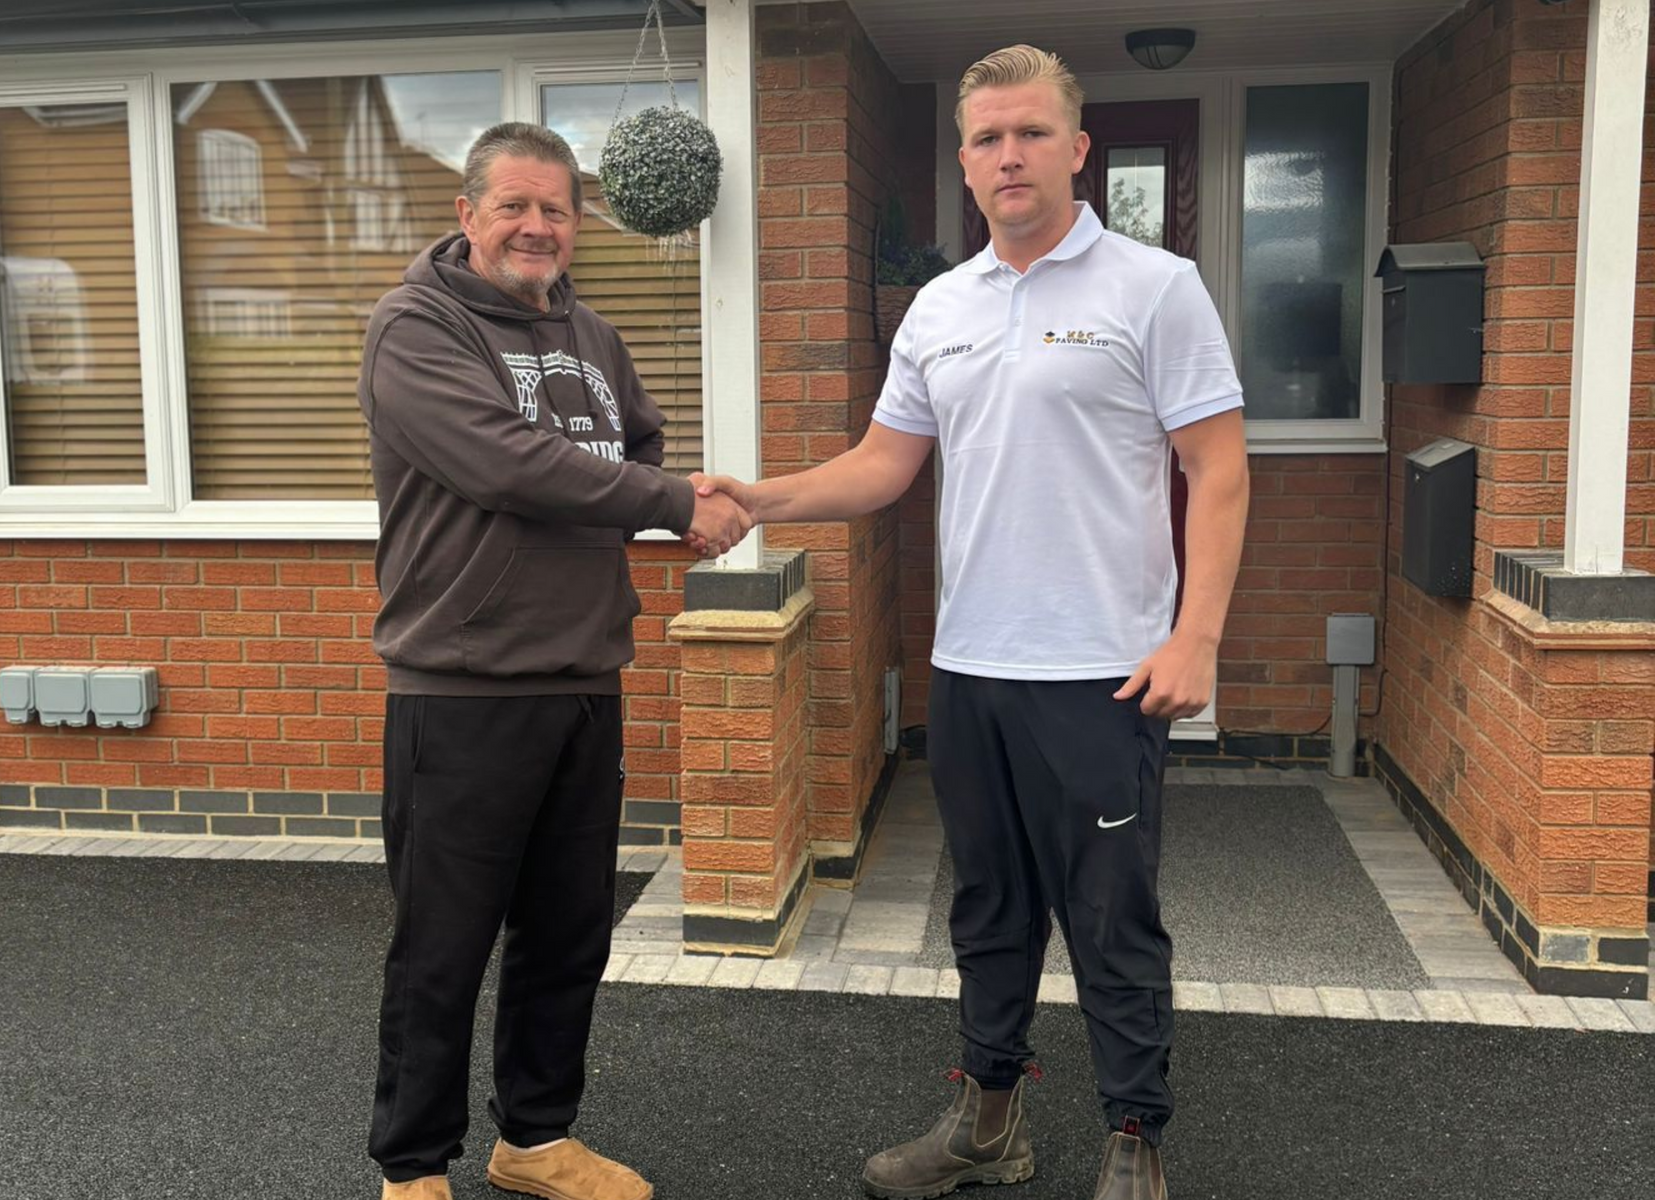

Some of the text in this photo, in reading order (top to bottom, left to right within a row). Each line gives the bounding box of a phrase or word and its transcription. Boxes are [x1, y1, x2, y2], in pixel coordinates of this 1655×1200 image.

[1089, 338, 1109, 347] LTD
[938, 343, 974, 359] JAMES
[568, 416, 594, 432] 1779
